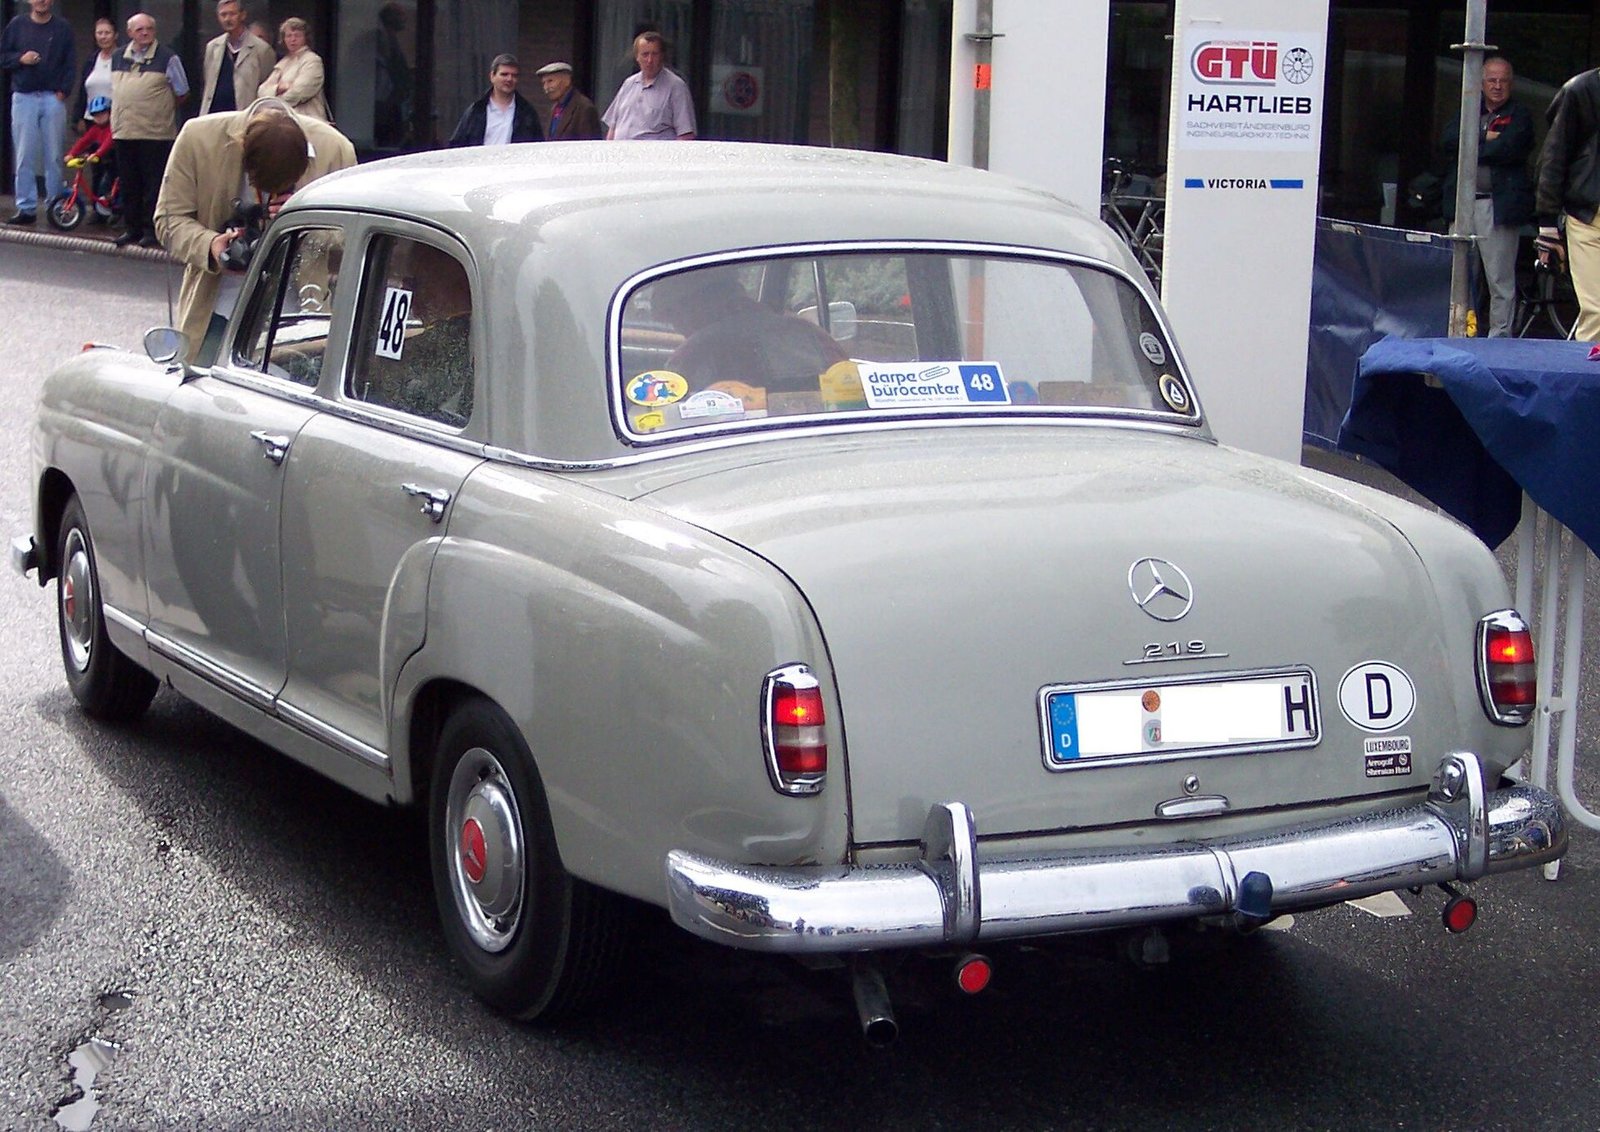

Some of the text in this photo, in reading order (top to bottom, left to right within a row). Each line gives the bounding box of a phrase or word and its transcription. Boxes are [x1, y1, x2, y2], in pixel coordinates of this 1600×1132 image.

[1197, 41, 1278, 80] GTÜ
[1187, 94, 1312, 114] HARTLIEB
[1208, 179, 1267, 189] VICTORIA
[380, 291, 408, 353] 48
[868, 371, 917, 386] darpe
[970, 373, 995, 392] 48
[871, 383, 960, 397] bürocenter
[1143, 640, 1206, 657] 219
[1365, 673, 1393, 720] D
[1061, 685, 1312, 748] D H
[1366, 739, 1409, 752] LUXEMBOURG
